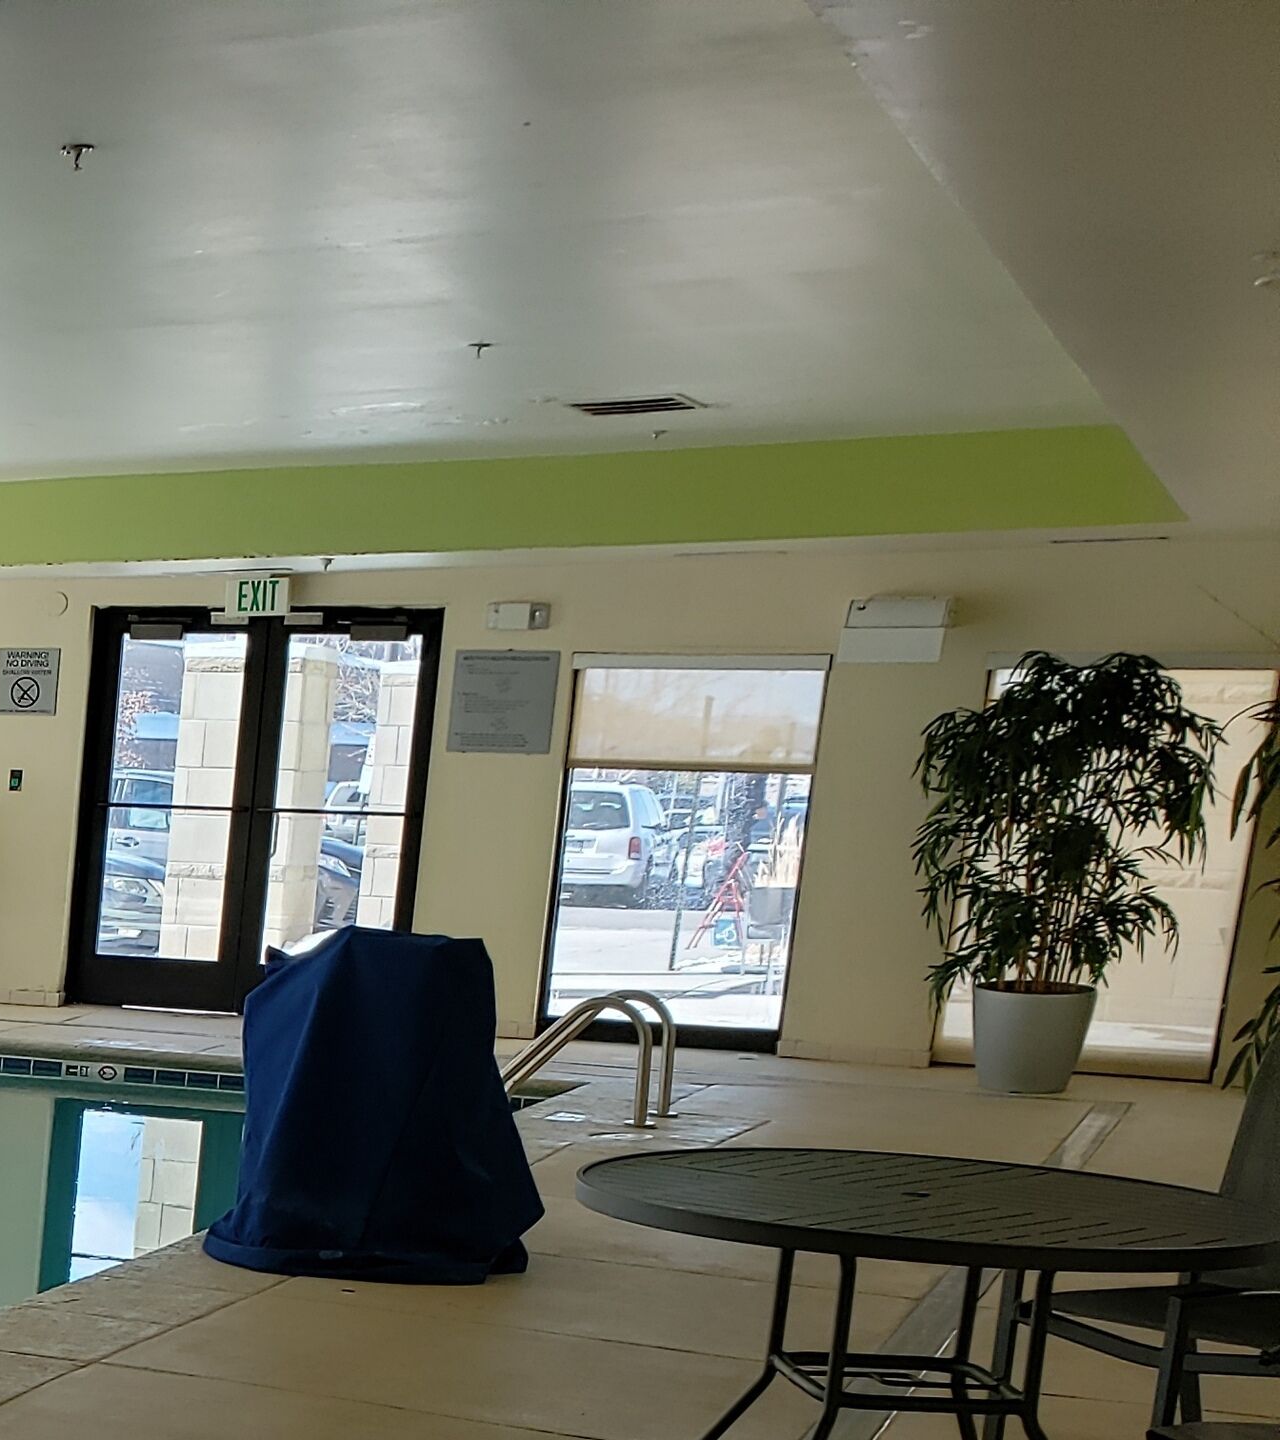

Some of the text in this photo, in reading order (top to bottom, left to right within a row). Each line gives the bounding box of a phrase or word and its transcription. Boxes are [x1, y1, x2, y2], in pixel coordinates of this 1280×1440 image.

[238, 580, 279, 612] EXIT
[6, 659, 50, 668] NO DIVING
